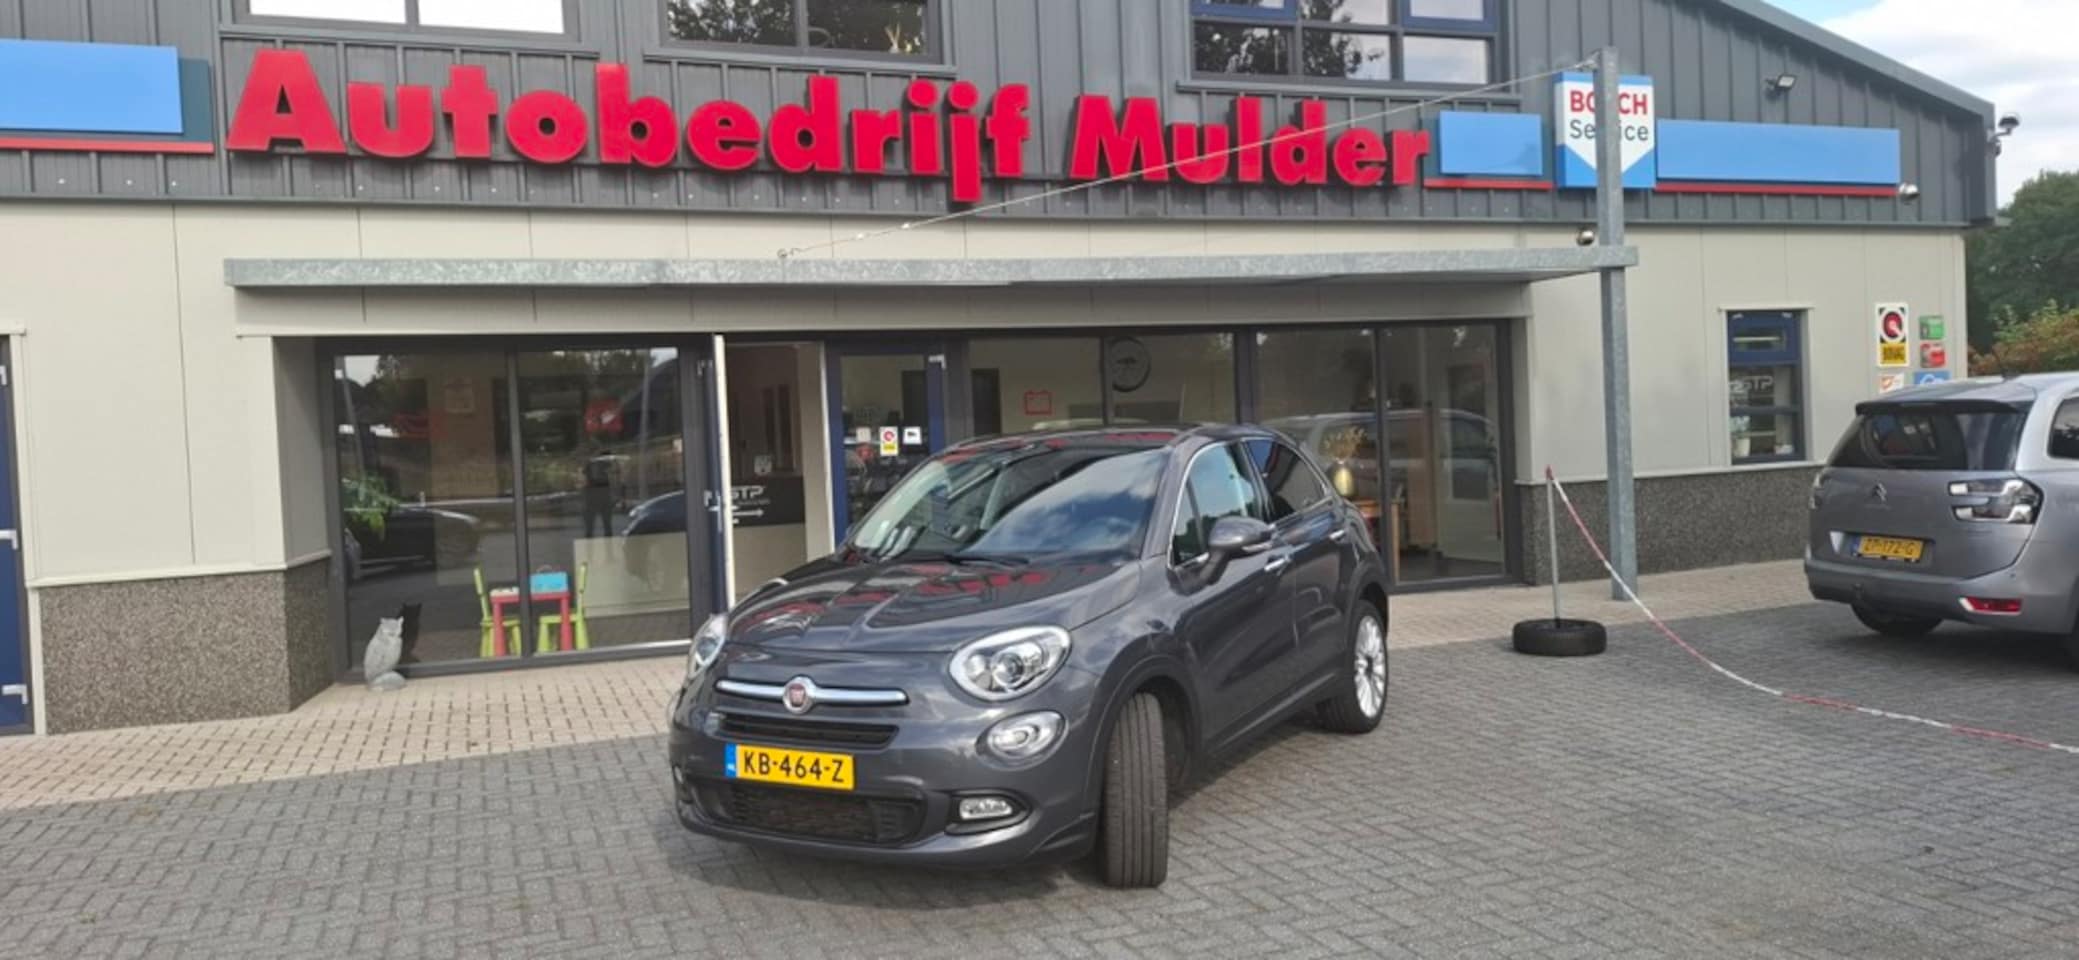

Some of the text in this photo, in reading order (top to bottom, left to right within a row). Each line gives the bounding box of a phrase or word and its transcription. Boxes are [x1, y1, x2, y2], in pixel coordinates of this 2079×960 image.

[1569, 90, 1648, 115] BOCH
[226, 50, 1431, 202] Autobedrijf Mulder
[744, 750, 845, 783] KB-464-Z
